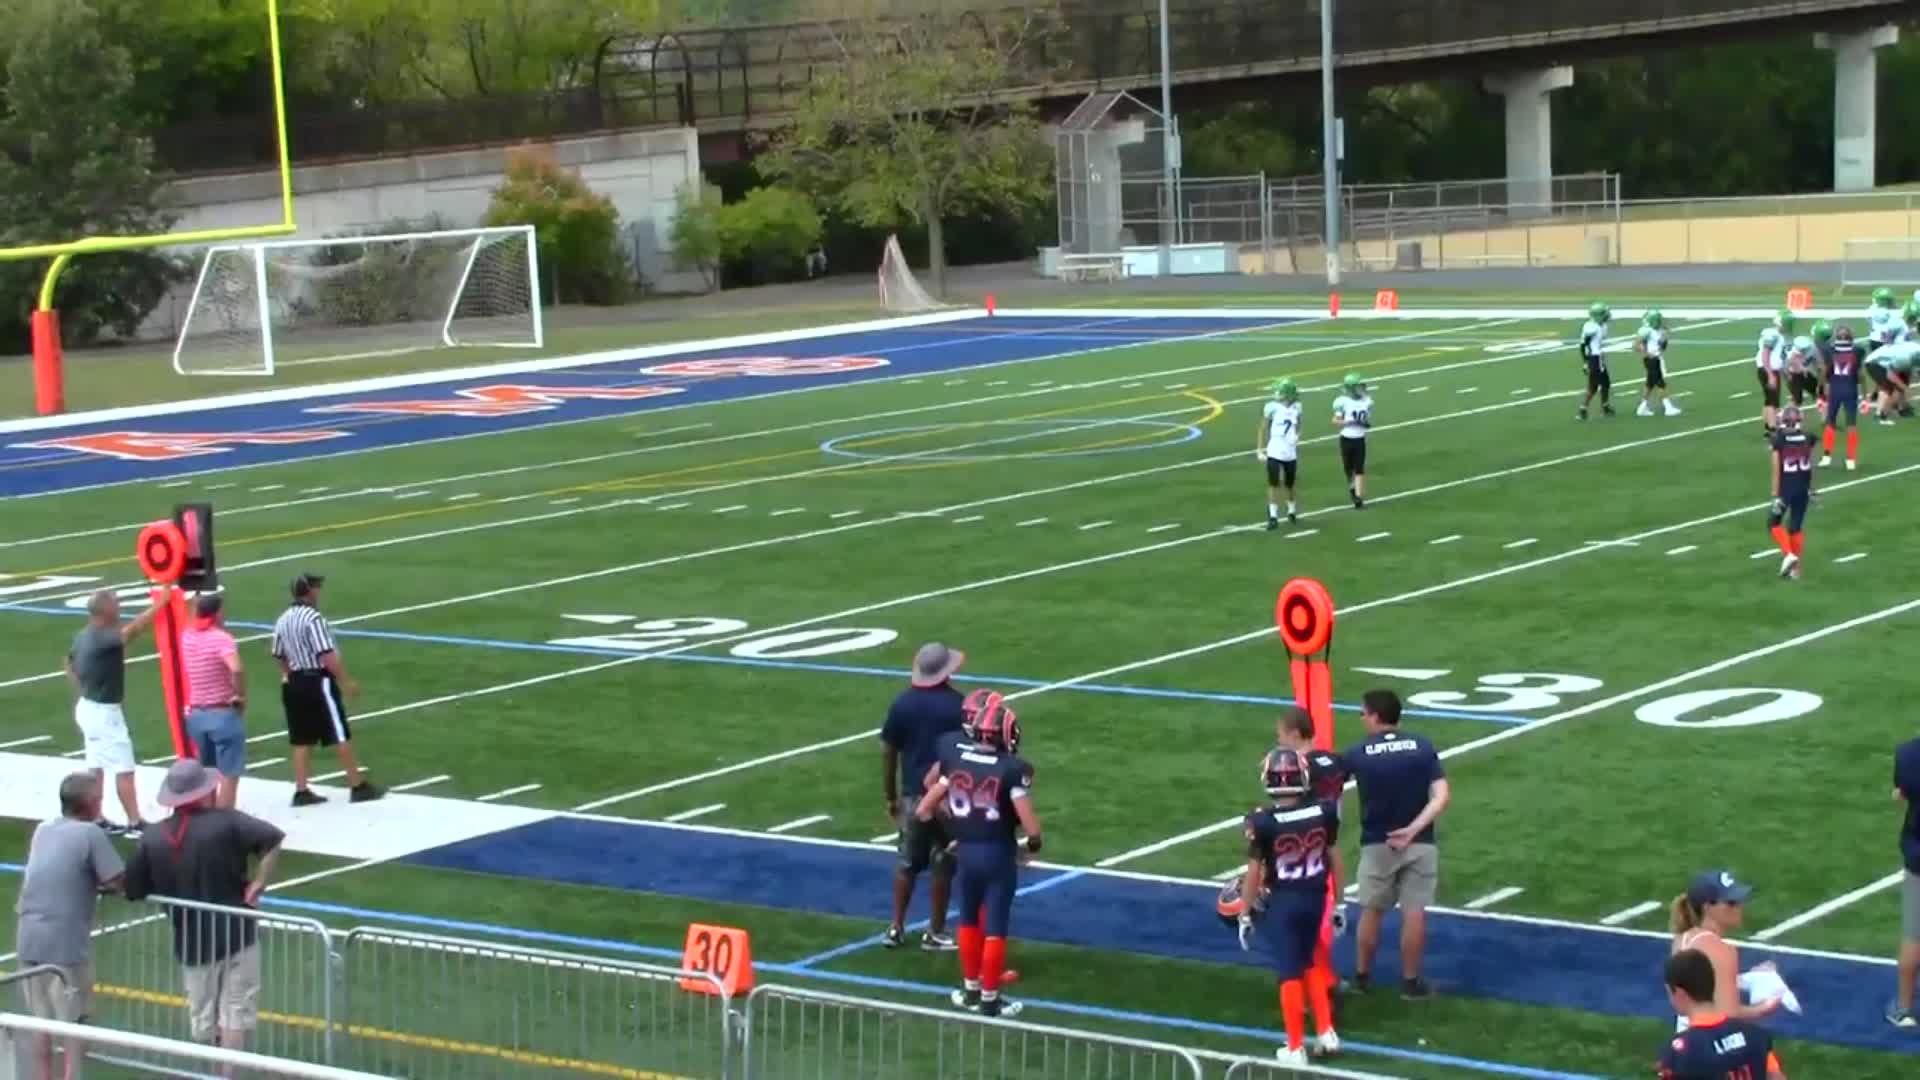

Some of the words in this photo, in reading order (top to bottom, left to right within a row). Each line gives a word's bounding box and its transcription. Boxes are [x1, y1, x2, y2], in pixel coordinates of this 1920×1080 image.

[949, 769, 1000, 820] 64
[1275, 828, 1325, 879] 22
[691, 930, 732, 980] 30
